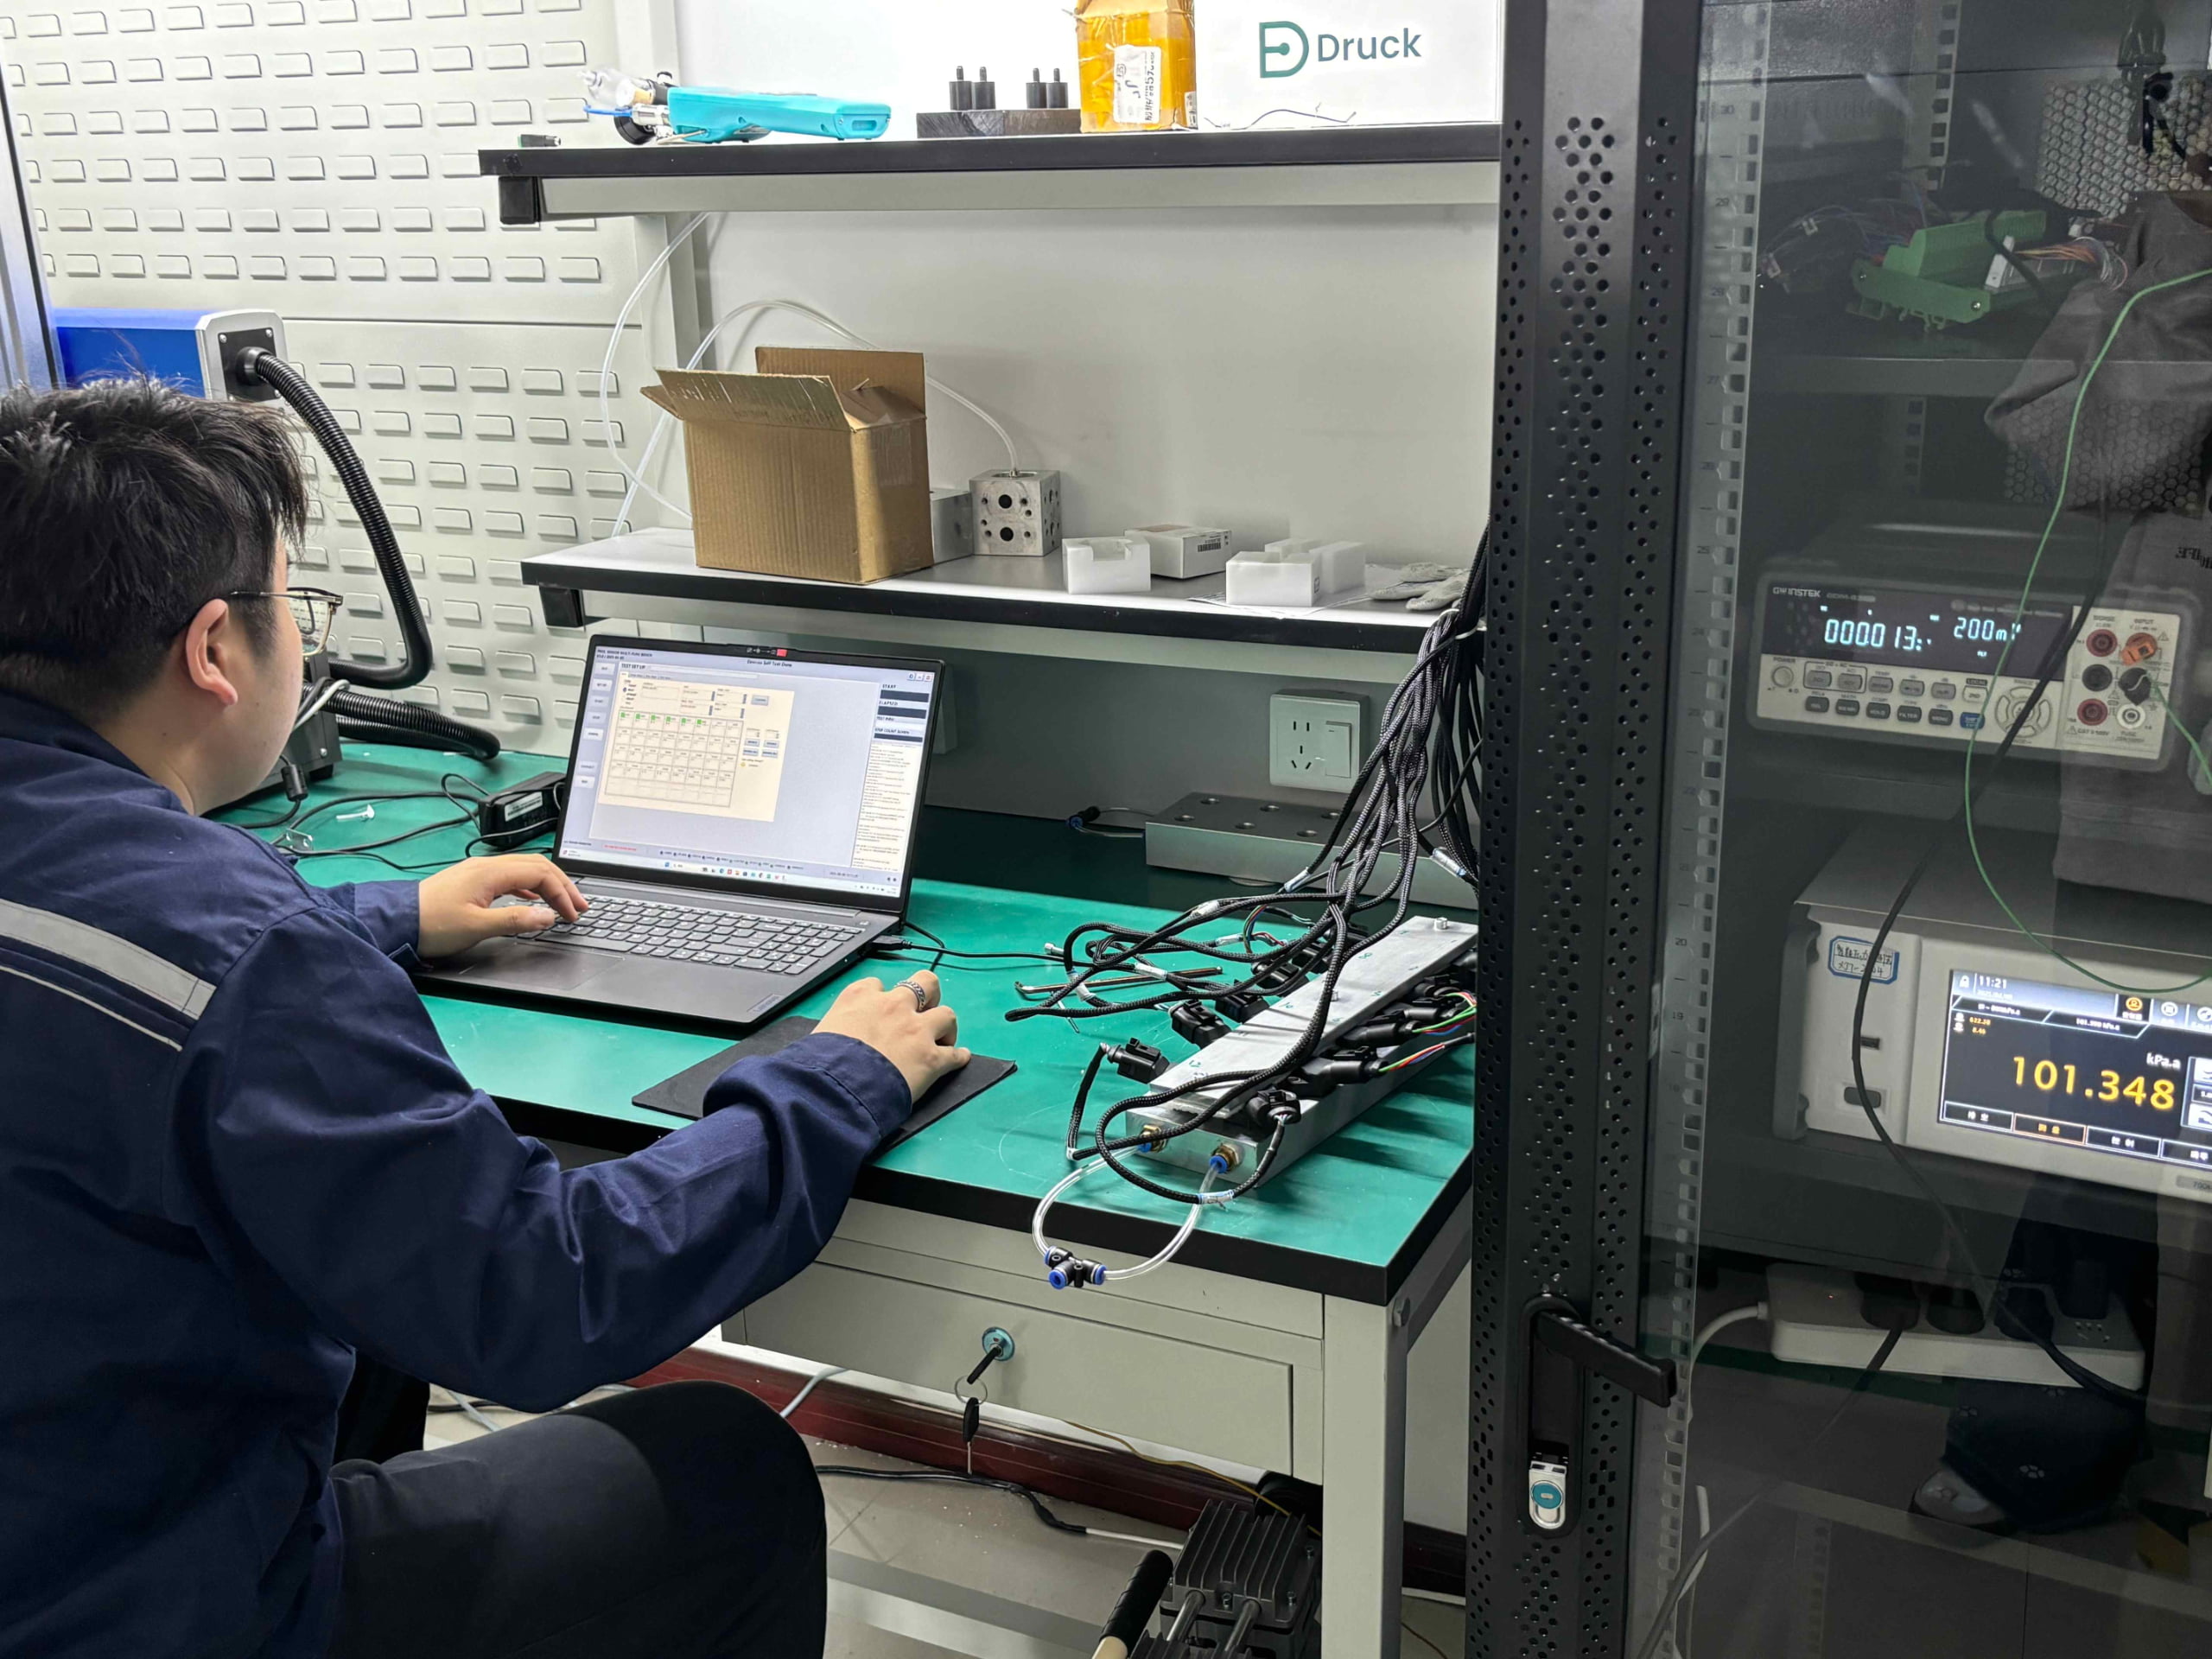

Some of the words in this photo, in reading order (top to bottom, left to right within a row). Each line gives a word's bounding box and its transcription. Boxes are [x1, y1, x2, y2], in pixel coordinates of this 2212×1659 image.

[1318, 28, 1422, 62] Druck
[1980, 976, 2007, 988] 11:21
[2146, 1052, 2182, 1071] kPa.a
[2014, 1056, 2176, 1109] 101.348
